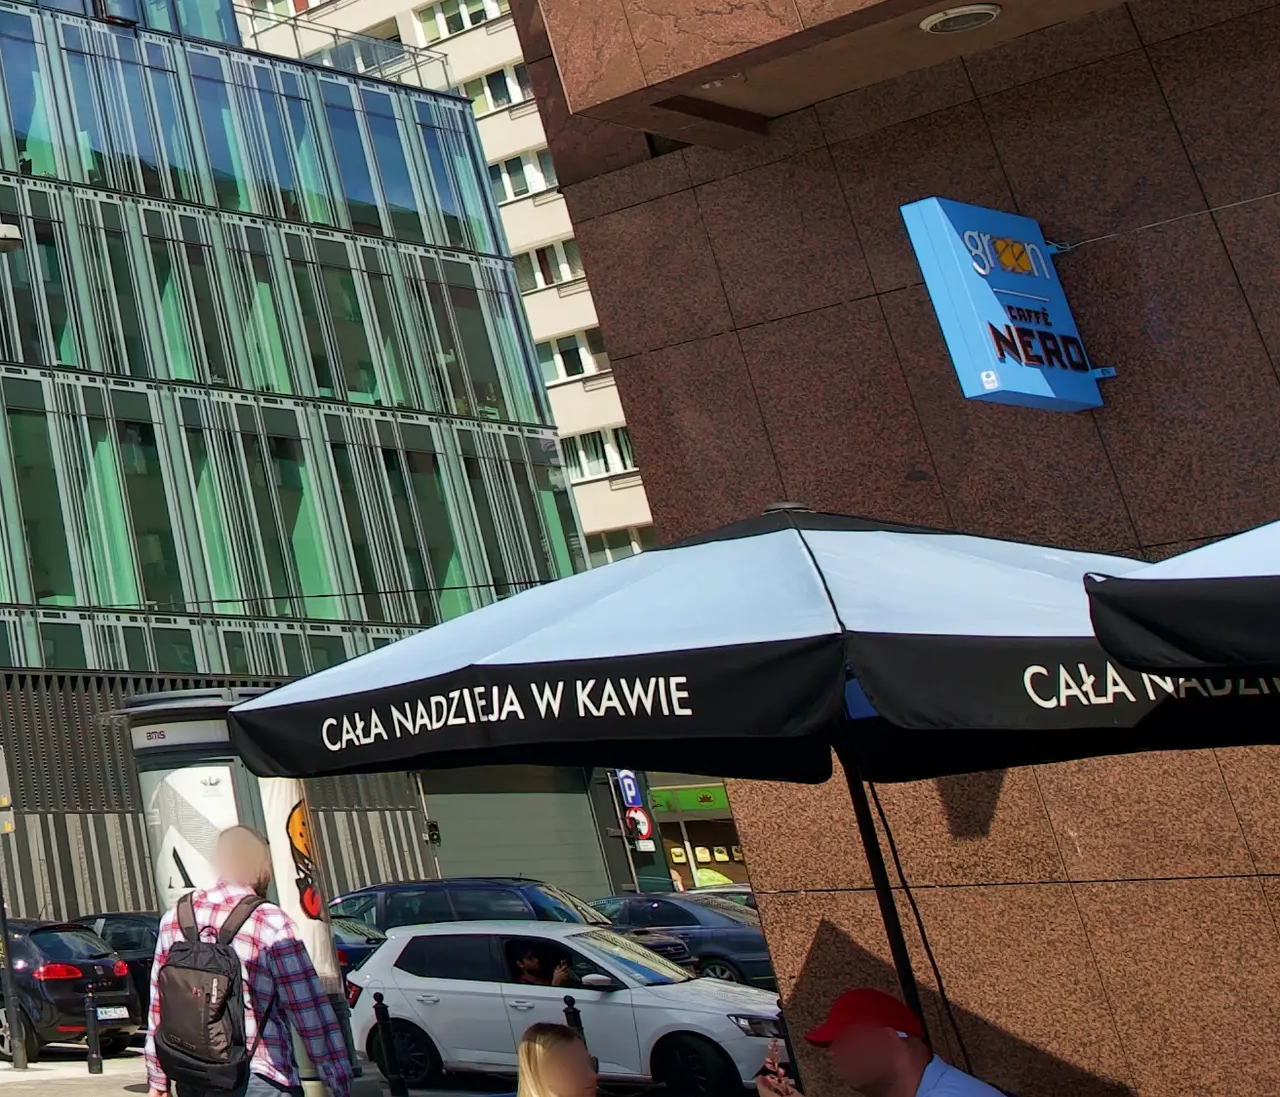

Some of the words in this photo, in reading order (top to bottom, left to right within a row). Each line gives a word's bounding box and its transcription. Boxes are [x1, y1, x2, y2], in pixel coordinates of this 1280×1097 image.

[987, 320, 1090, 373] NERO
[1022, 660, 1137, 709] CAŁA
[321, 707, 389, 752] CAŁA
[390, 684, 526, 739] NADZIEJA
[530, 680, 565, 720] W
[575, 675, 693, 718] KAWIE
